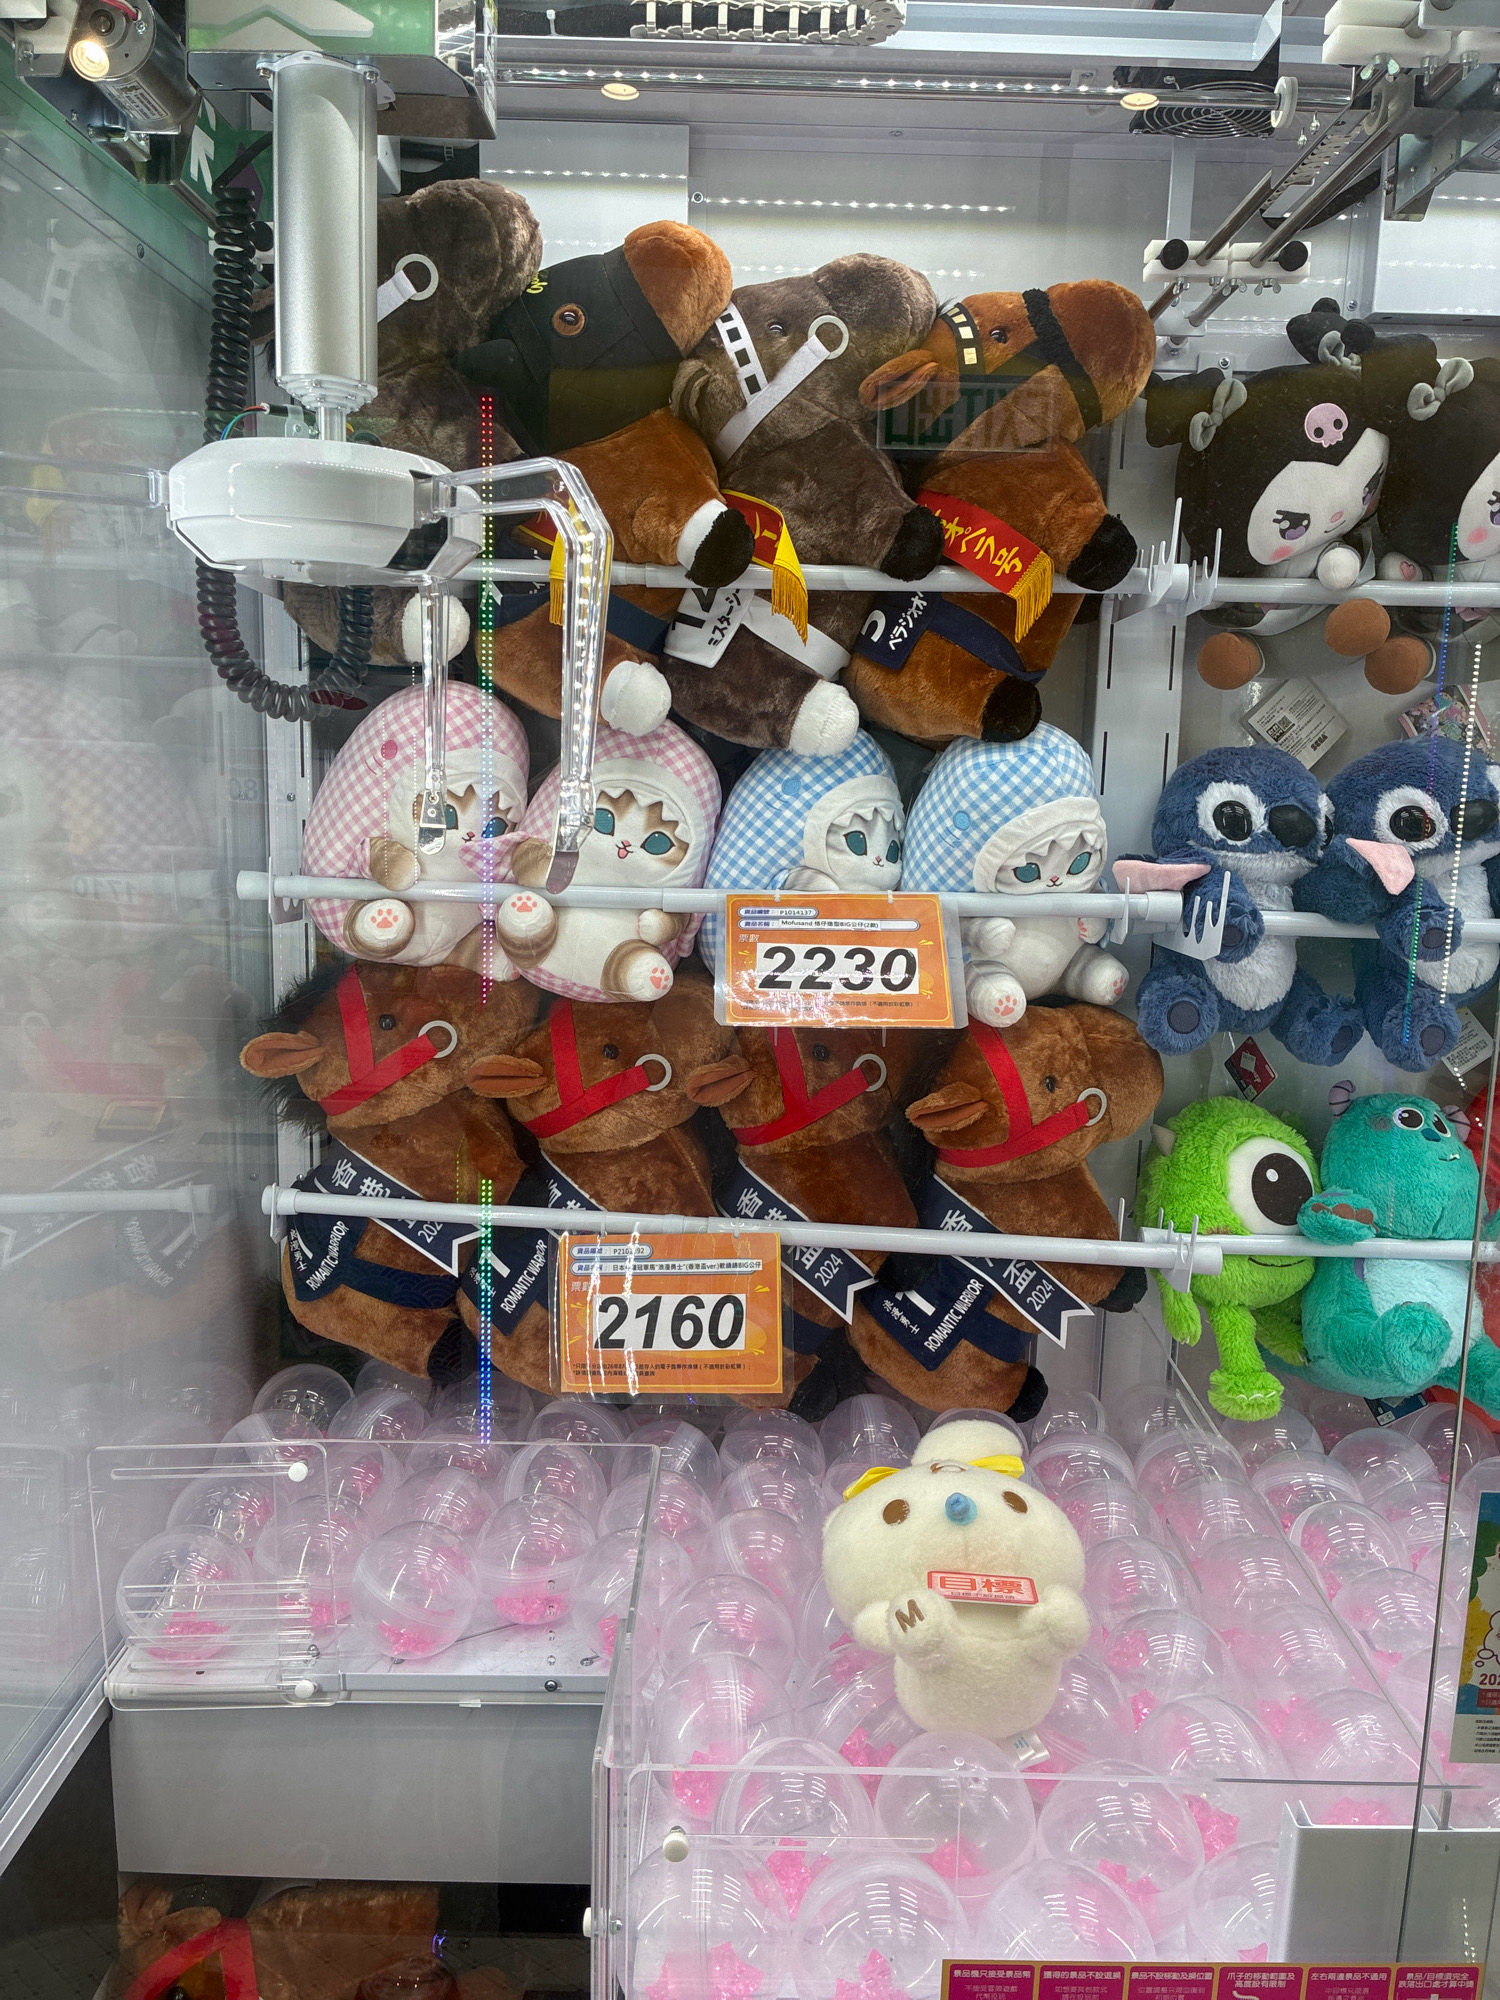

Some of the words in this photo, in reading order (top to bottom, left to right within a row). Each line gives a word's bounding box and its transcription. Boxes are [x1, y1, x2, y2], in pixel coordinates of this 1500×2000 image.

[758, 945, 917, 992] 2230
[814, 1253, 844, 1287] 2024
[500, 1270, 536, 1314] ROMANTIC
[1026, 1279, 1055, 1311] 2024
[594, 1294, 744, 1350] 2160
[924, 1309, 963, 1352] ROMANTIC
[953, 1278, 984, 1314] WARRIOR
[940, 1576, 1025, 1594] 目標
[895, 1598, 925, 1633] M
